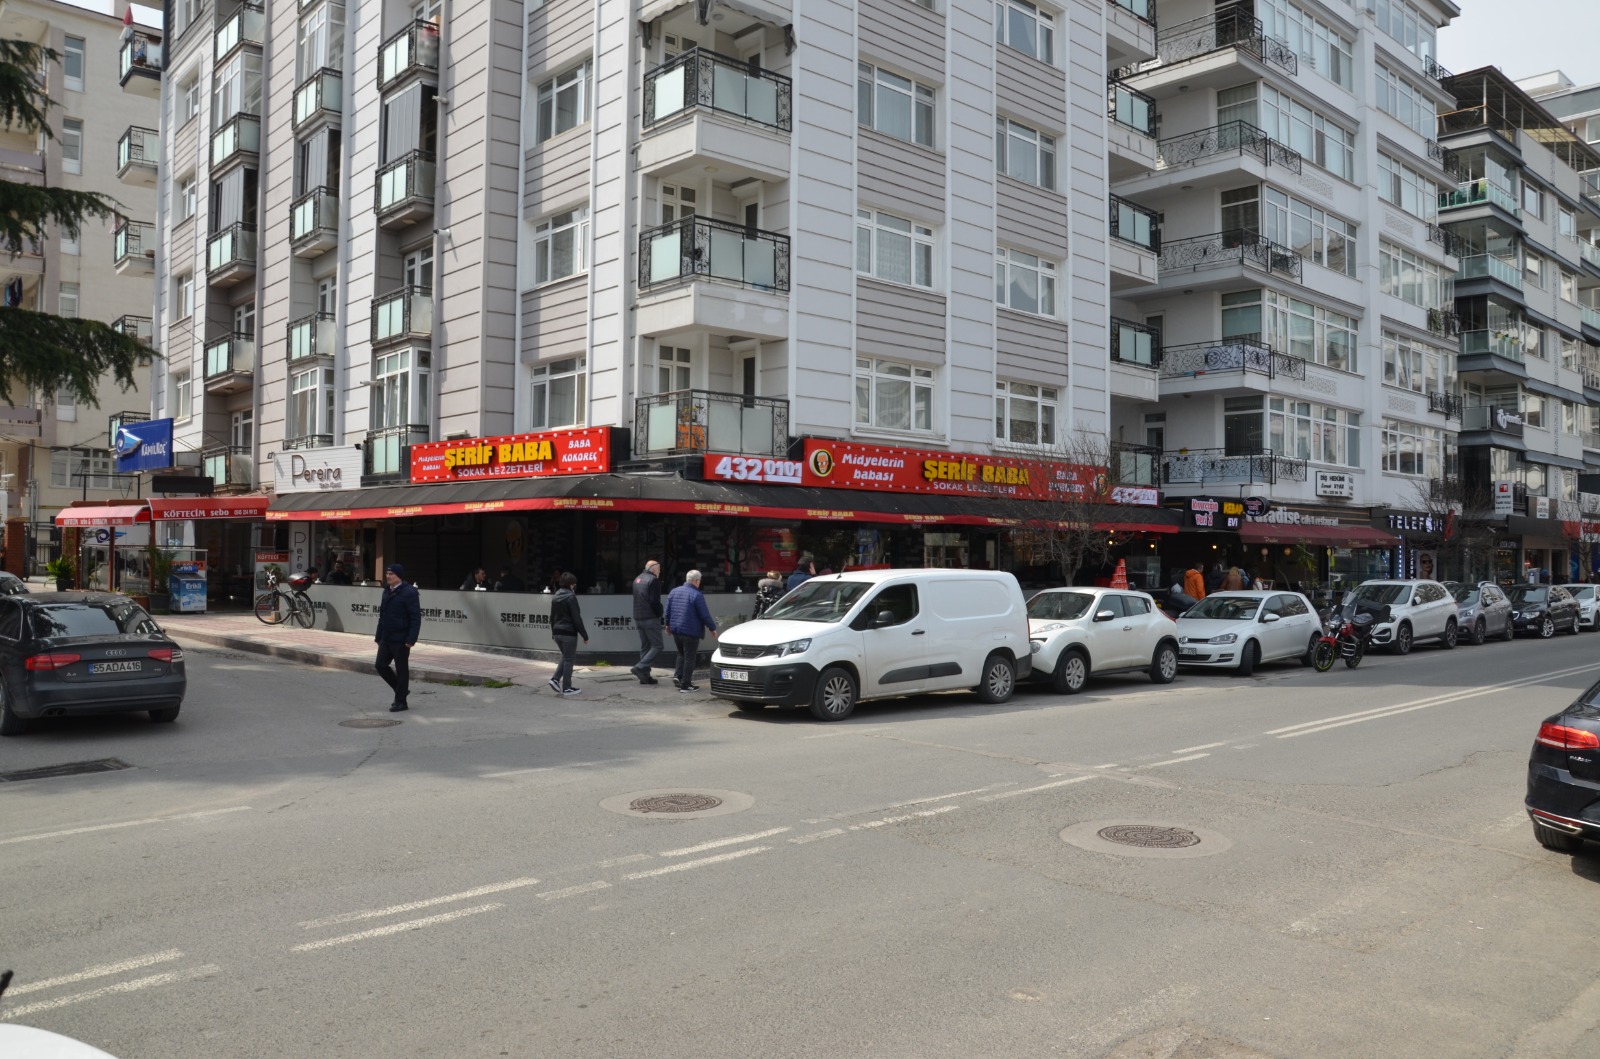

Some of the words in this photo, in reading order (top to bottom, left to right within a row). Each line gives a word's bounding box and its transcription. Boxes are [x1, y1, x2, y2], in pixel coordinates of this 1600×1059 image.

[568, 439, 591, 449] BABA
[444, 442, 494, 470] ŞERİF
[498, 440, 553, 464] BABA
[562, 451, 597, 463] KOKOREÇ
[841, 453, 904, 469] Midyelerin
[291, 454, 342, 483] Pereira
[457, 468, 486, 478] SOKAK
[488, 462, 544, 476] LEZZETLERİ
[715, 456, 763, 482] 432
[764, 459, 803, 477] 0101
[853, 468, 894, 482] babası
[924, 458, 977, 482] ŞERİF
[982, 464, 1029, 486] BABA
[933, 481, 963, 492] SOKAK
[553, 498, 578, 506] ŞERİF
[581, 499, 613, 507] BABA
[163, 508, 206, 518] KÖFTECİM
[210, 508, 230, 516] sebo
[1207, 513, 1214, 527] 2
[500, 611, 526, 624] ŞERİF
[594, 615, 632, 628] ŞERİF
